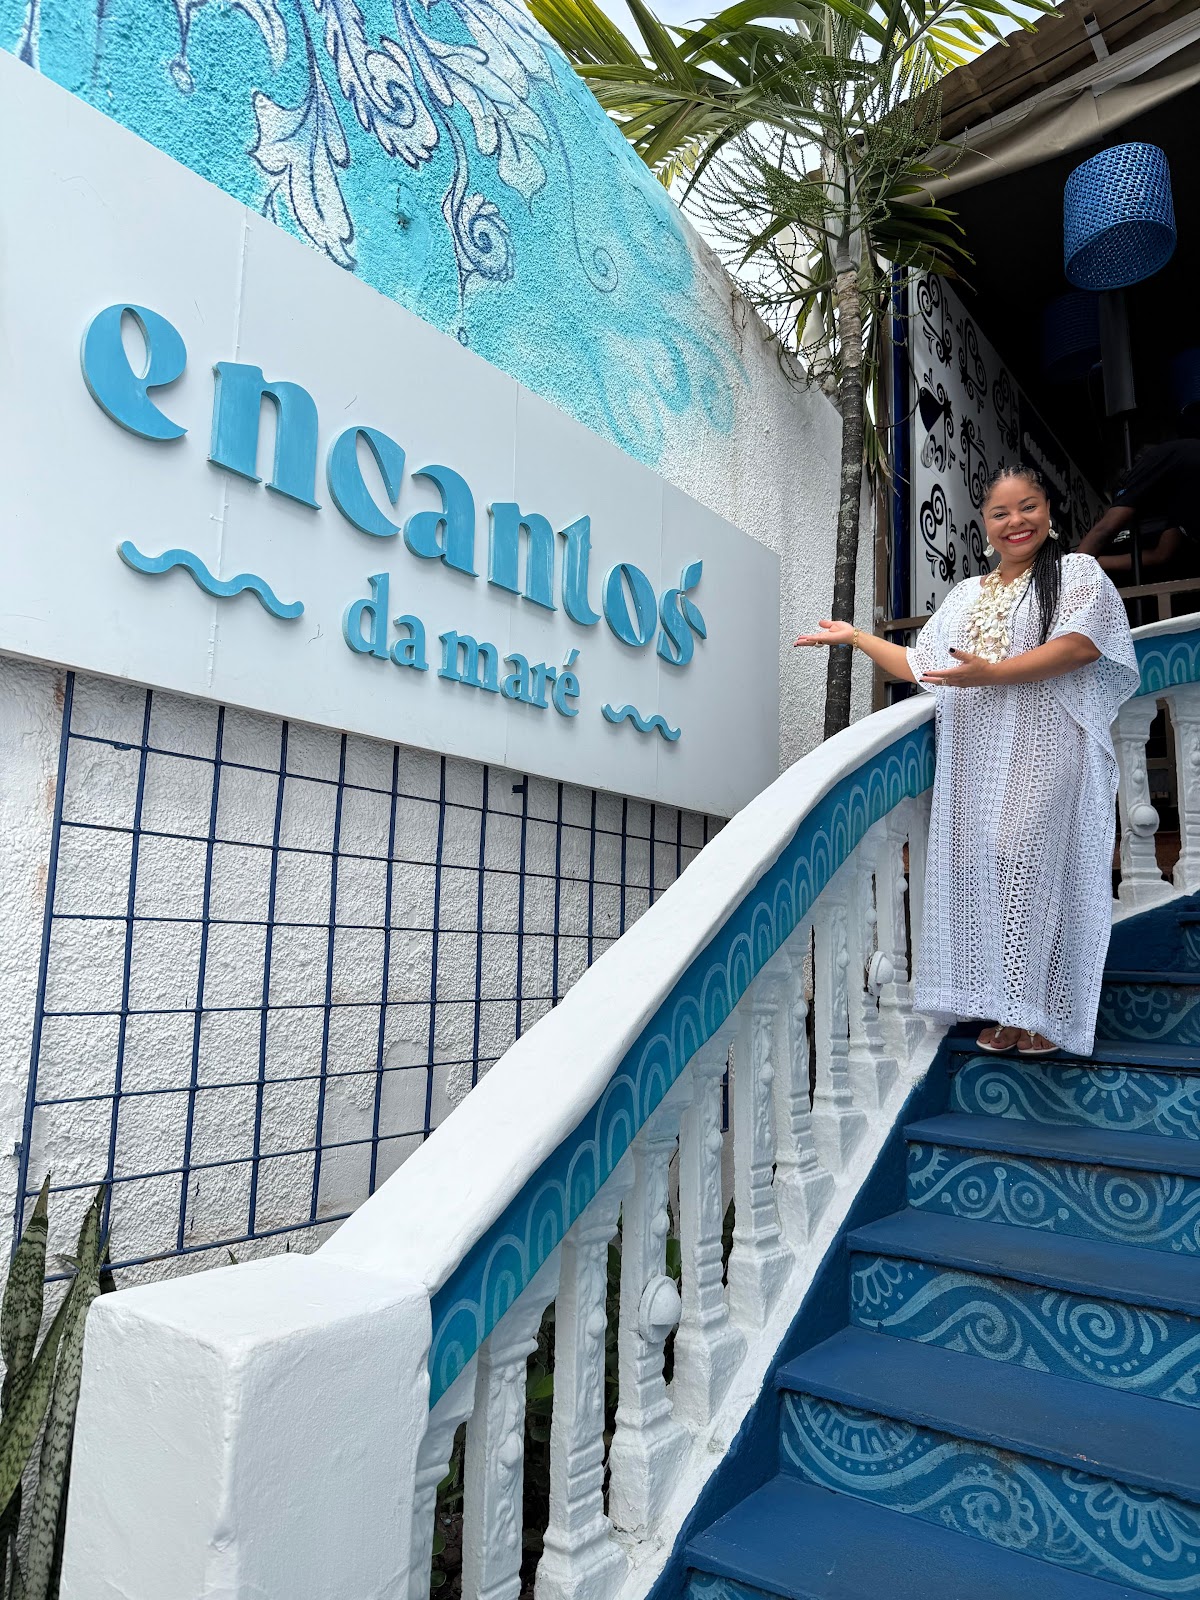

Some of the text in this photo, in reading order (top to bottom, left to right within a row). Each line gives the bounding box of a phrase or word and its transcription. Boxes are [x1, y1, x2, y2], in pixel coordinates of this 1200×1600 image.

[81, 304, 706, 666] encantos
[342, 573, 580, 717] da maré
